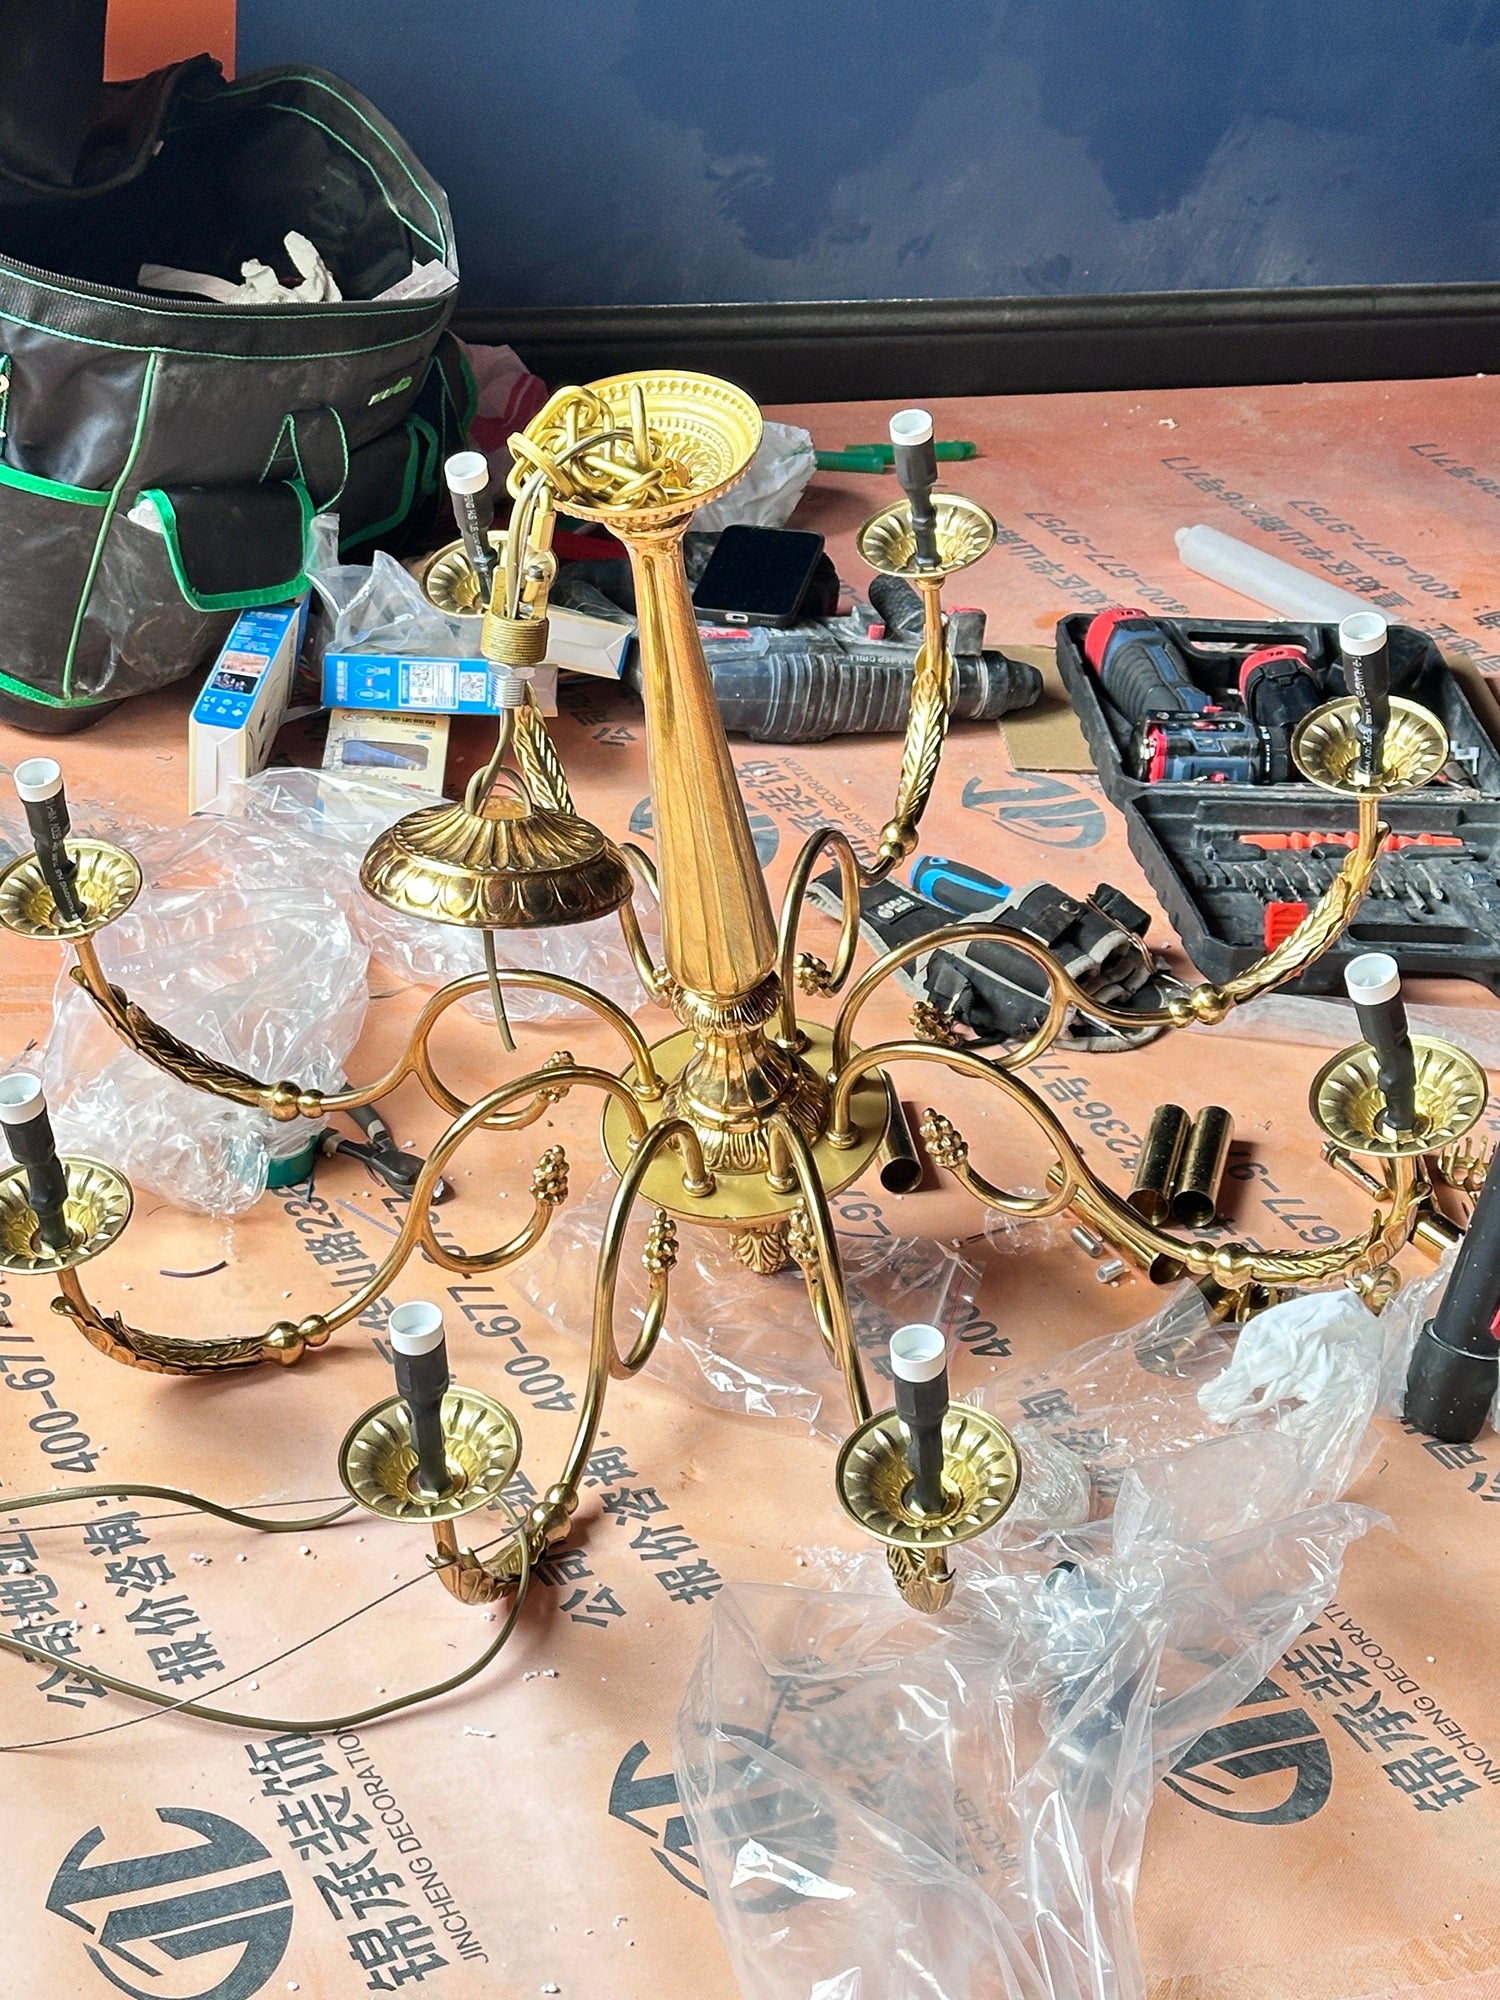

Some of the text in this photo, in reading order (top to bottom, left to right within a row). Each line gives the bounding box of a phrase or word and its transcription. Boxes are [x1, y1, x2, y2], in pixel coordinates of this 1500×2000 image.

[1024, 512, 1190, 614] 400-677-9757
[1288, 500, 1462, 600] 400-677-9757
[1280, 1612, 1484, 1814] 锦承装
[246, 1730, 450, 1993] 锦承装饰
[404, 1854, 489, 1965] JINCHENG
